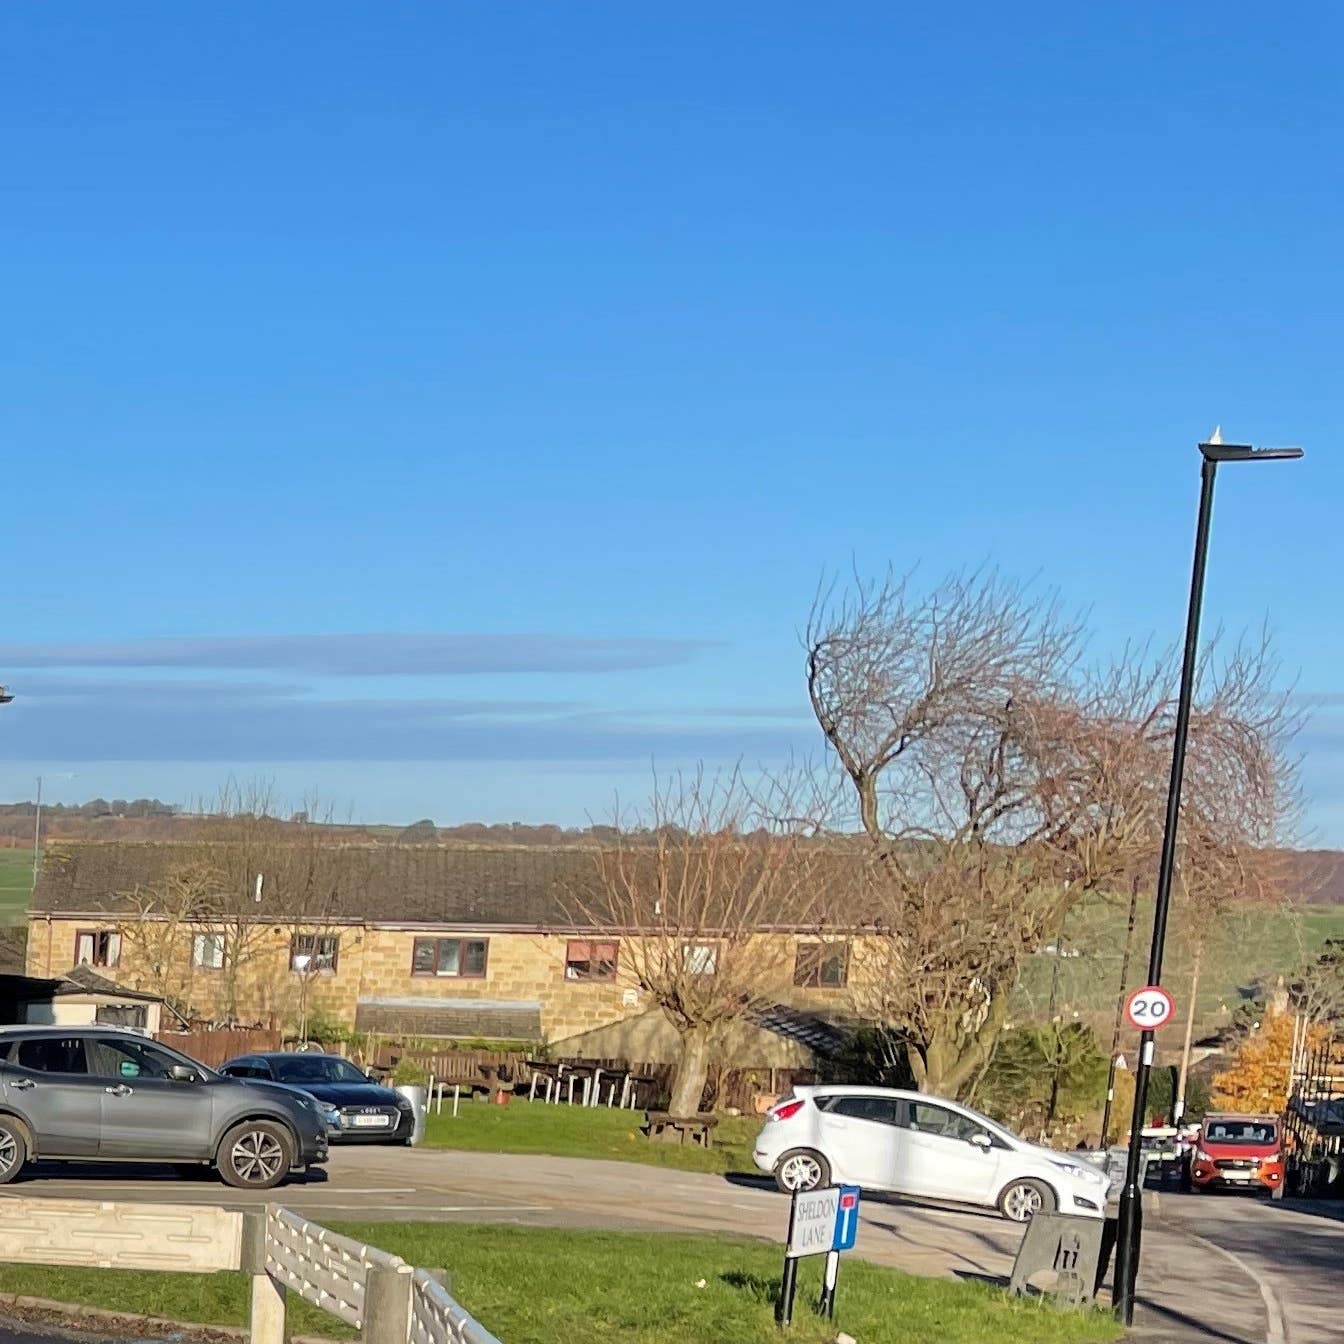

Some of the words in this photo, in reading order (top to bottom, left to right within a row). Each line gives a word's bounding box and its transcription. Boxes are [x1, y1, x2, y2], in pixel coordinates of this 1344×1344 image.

[1133, 999, 1166, 1017] 20
[798, 1198, 836, 1222] SHELDON
[801, 1224, 826, 1247] LANE
